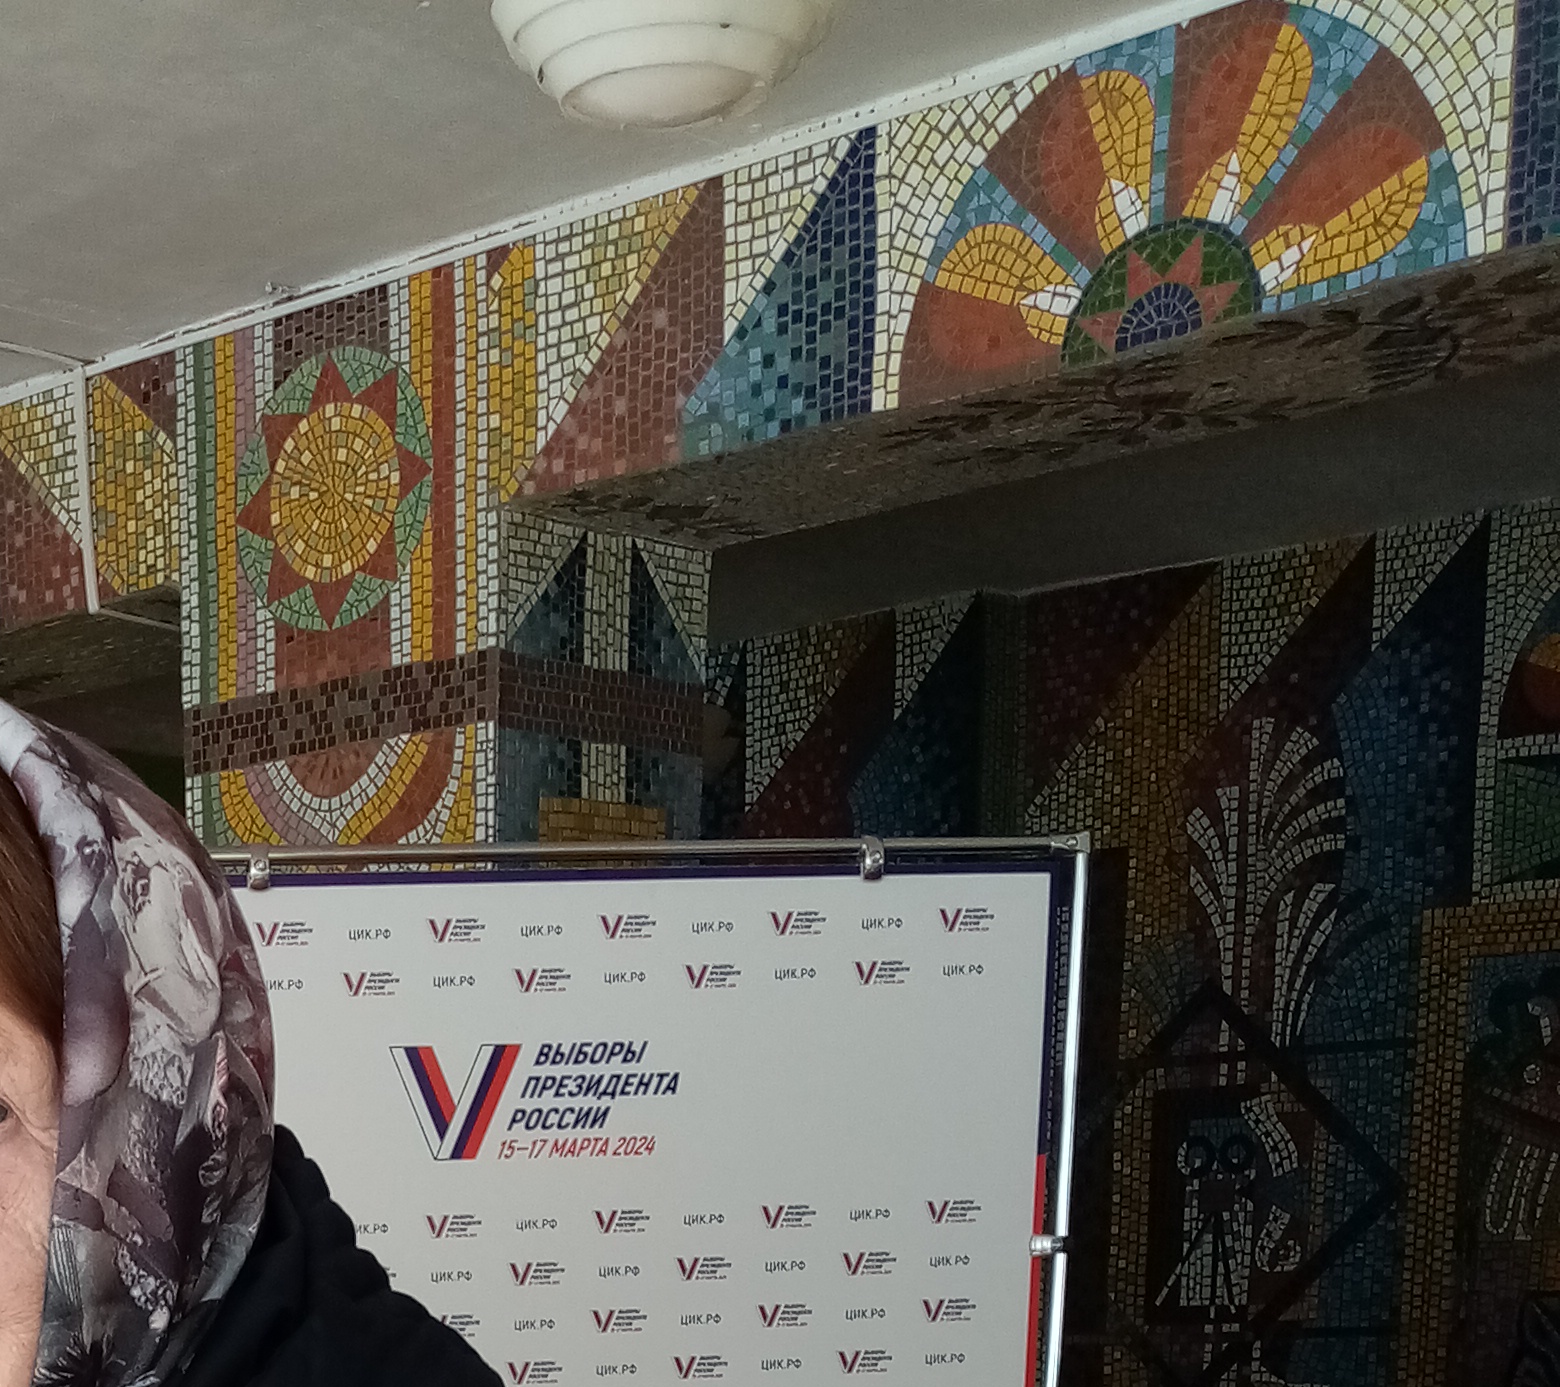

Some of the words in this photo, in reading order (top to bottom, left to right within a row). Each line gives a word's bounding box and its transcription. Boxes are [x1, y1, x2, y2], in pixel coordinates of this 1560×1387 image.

[266, 979, 304, 991] ИК.РФ
[533, 1040, 649, 1067] ВЫБОРЫ
[520, 1072, 680, 1100] ПРЕЗИДЕНТА
[507, 1105, 611, 1132] РОССИИ
[549, 1137, 610, 1159] МАРТА
[612, 1135, 656, 1157] 2024
